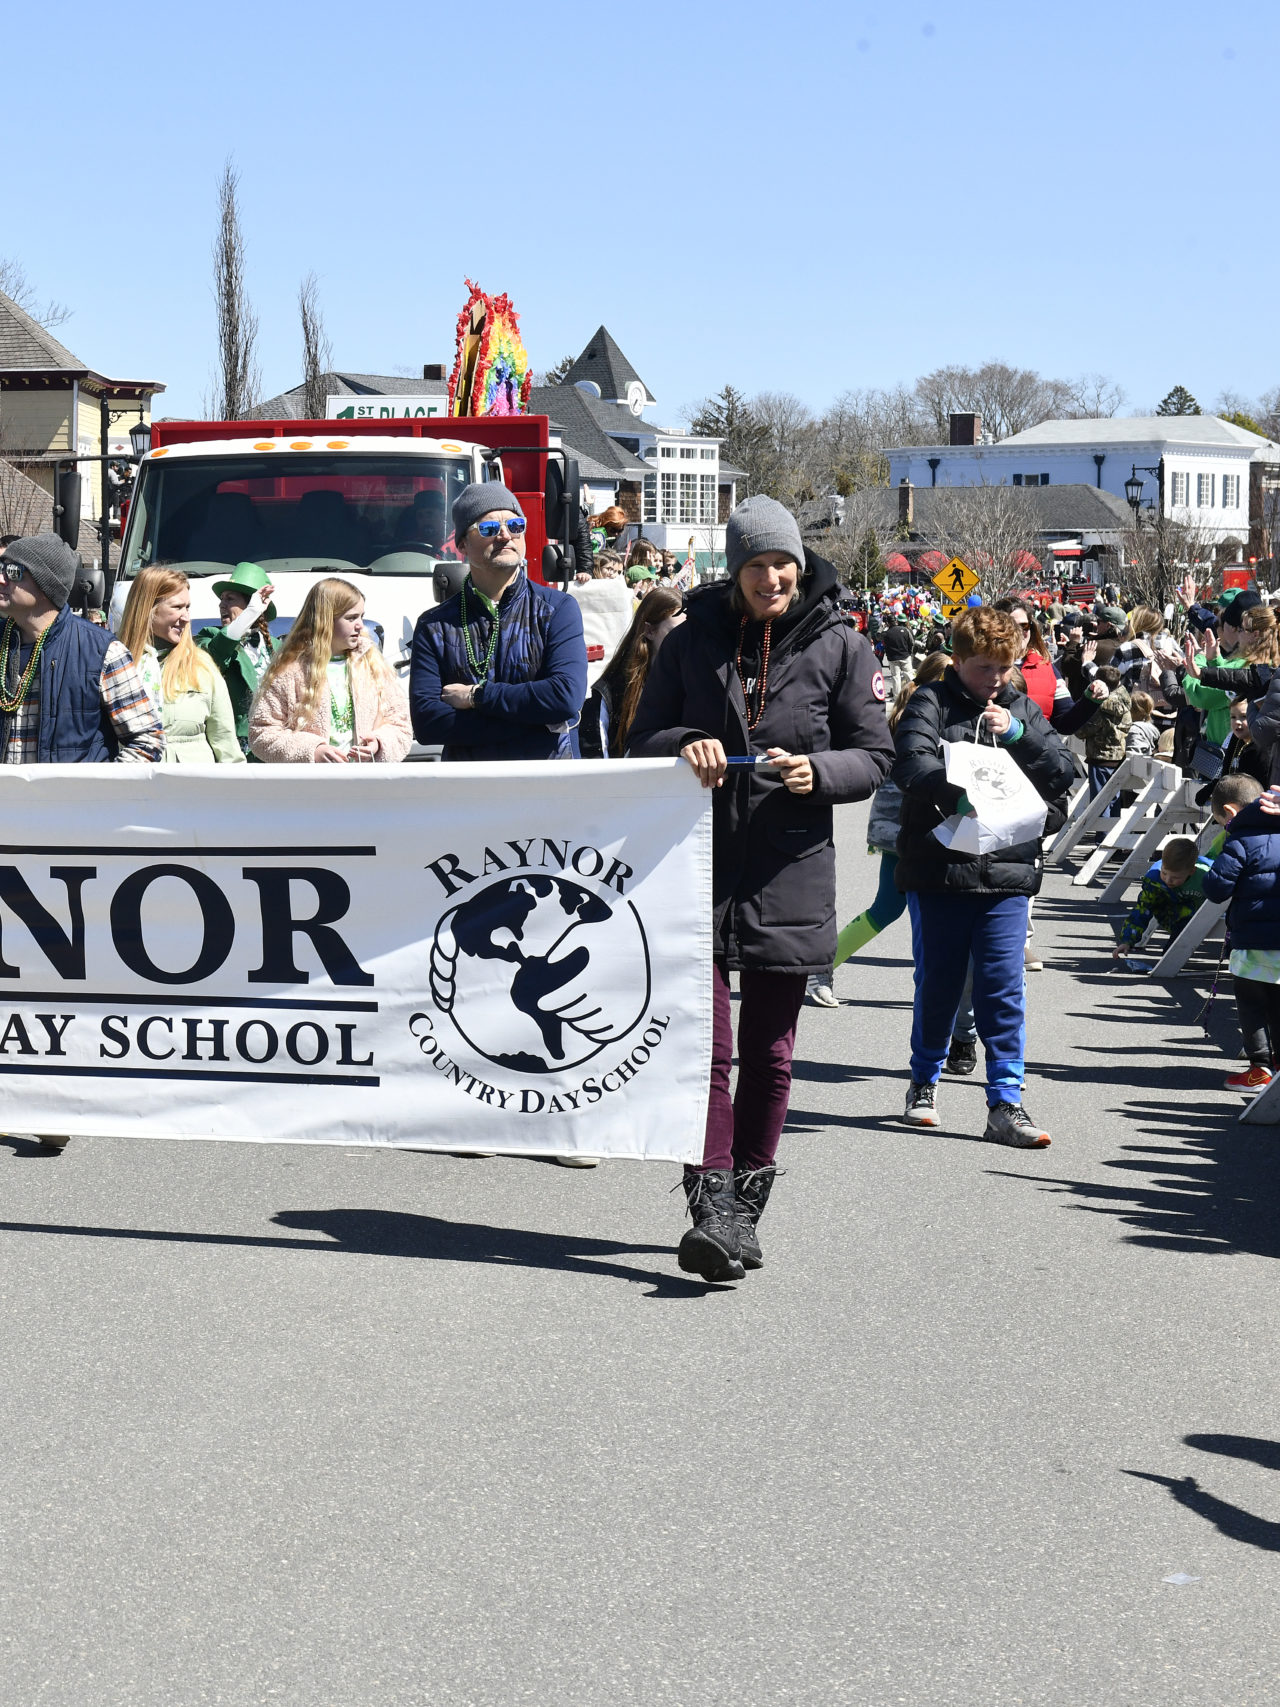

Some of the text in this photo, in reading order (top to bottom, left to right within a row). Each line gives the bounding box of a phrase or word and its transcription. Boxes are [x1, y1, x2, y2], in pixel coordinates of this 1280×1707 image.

[424, 838, 634, 898] RAYNOR
[99, 1015, 374, 1067] SCHOOL
[409, 1012, 515, 1110] COUNTRY
